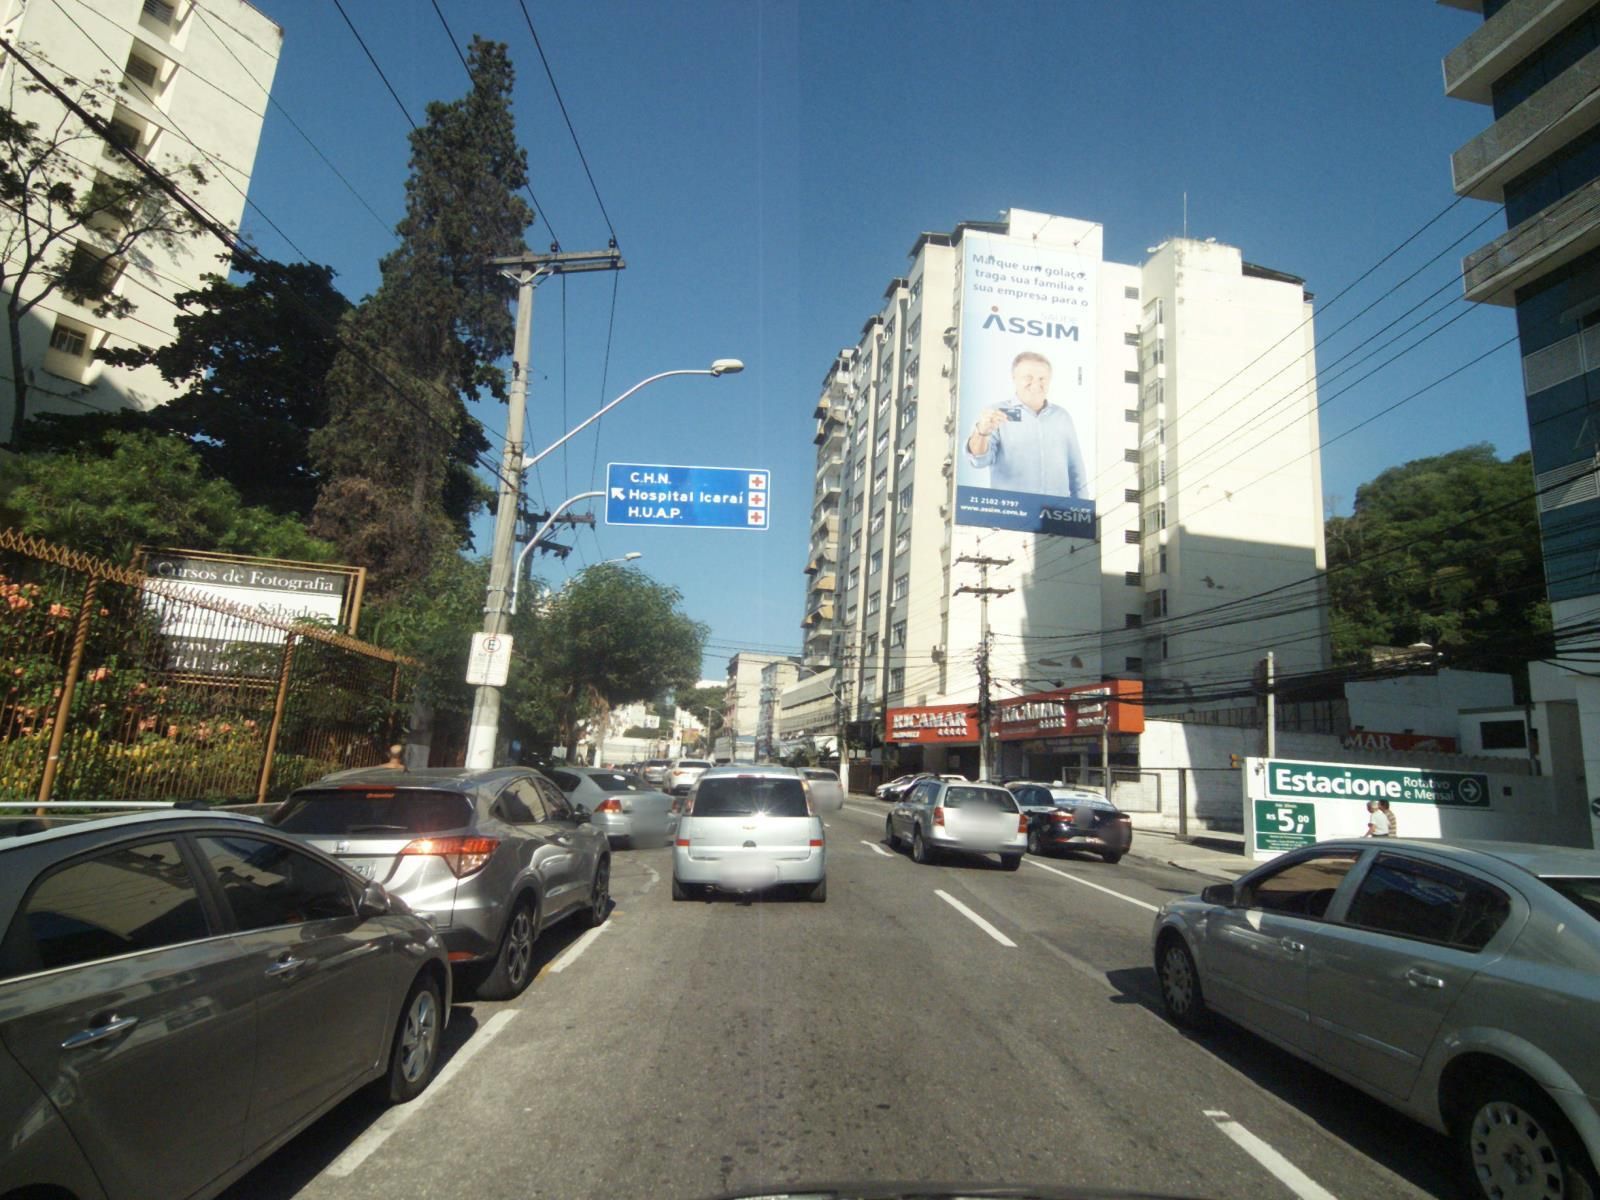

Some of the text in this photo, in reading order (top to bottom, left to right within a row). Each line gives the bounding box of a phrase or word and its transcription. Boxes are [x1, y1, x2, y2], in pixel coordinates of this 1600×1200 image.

[972, 254, 1019, 270] Marque
[1022, 264, 1042, 273] um
[975, 269, 1007, 282] traga
[1011, 275, 1030, 285] sua
[973, 283, 994, 293] sua
[997, 287, 1048, 302] empresa
[1051, 296, 1077, 306] para
[982, 309, 1079, 342] ASSIM
[630, 472, 672, 485] C.H.N.
[628, 489, 743, 504] Hospital Icaraí
[628, 506, 683, 519] H.U.A.P.
[1039, 507, 1092, 524] ASSIM
[158, 561, 333, 591] Cursos de Fotografia
[1275, 768, 1402, 797] Estacione
[1403, 776, 1450, 790] Rotativo
[1404, 790, 1412, 799] e
